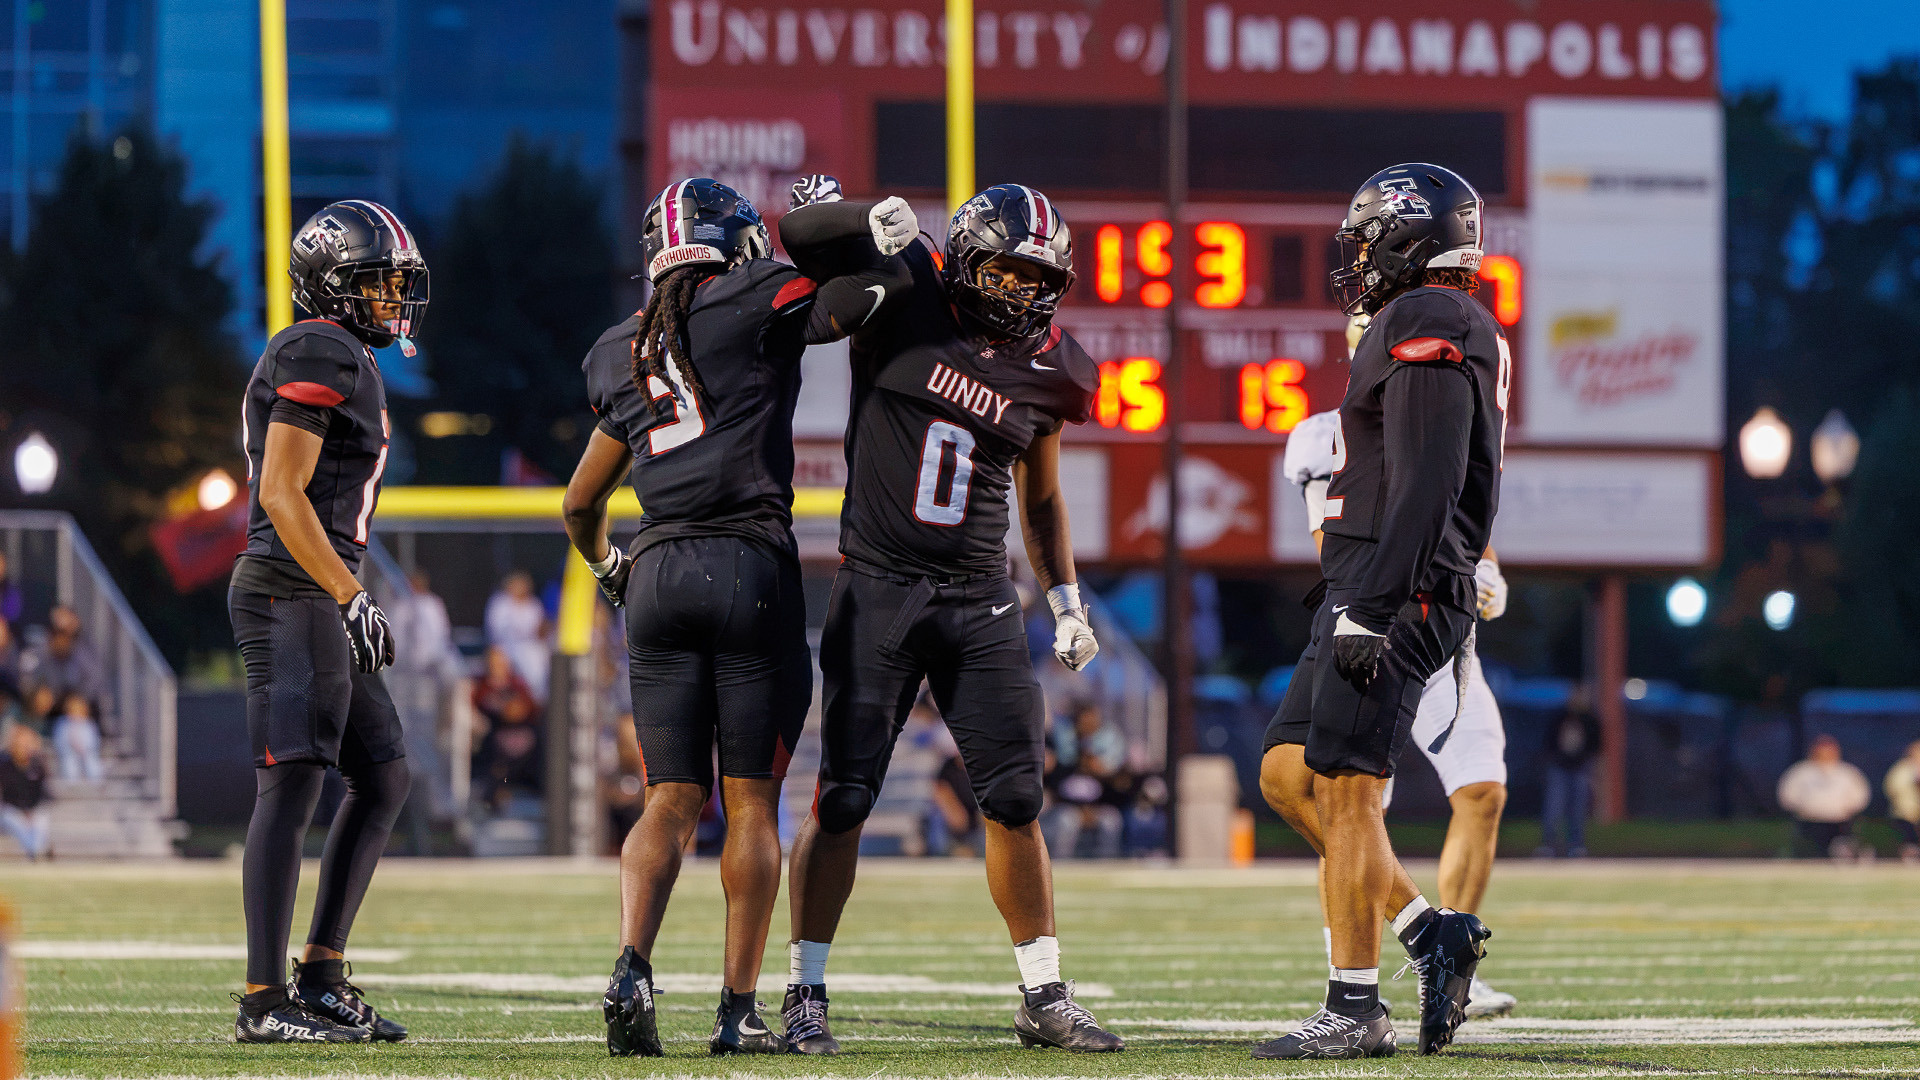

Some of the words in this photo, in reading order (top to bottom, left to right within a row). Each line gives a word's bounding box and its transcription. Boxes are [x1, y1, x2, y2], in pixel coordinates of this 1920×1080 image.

[1204, 4, 1706, 81] INDIANAPOLIS
[653, 246, 711, 274] GREYHOUNDS
[631, 330, 706, 456] 3
[926, 361, 1013, 425] UINDY
[1096, 357, 1167, 432] 15
[1239, 359, 1309, 433] 15
[912, 418, 976, 527] 0
[263, 1015, 330, 1041] BATTLE
[635, 977, 653, 1012] NIKE
